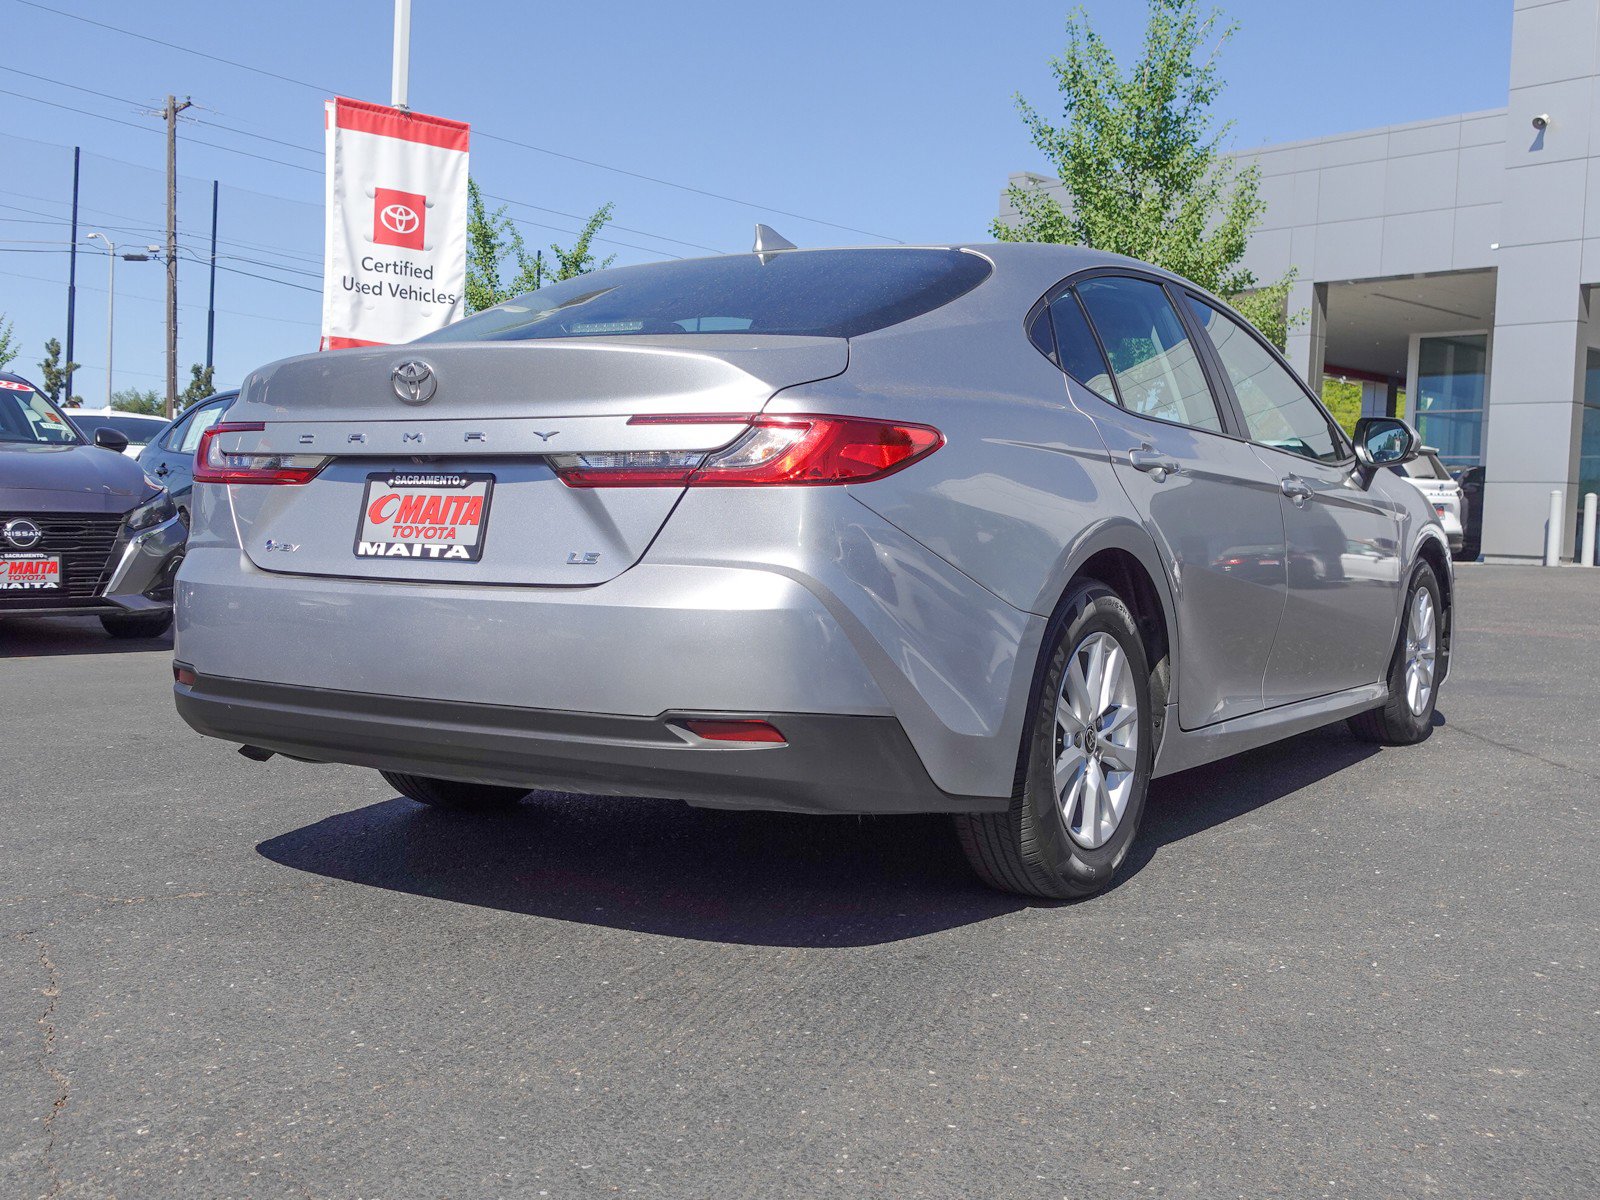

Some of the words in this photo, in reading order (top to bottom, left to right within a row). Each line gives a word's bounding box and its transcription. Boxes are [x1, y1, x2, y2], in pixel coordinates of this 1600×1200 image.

[361, 256, 433, 280] Certified
[342, 276, 383, 296] Used
[388, 281, 456, 305] Vehicles
[299, 431, 560, 443] CAMRY
[395, 475, 460, 485] SACRAMENTO
[392, 525, 456, 539] TOYOTA
[357, 542, 470, 559] MAITA
[566, 552, 601, 564] LE
